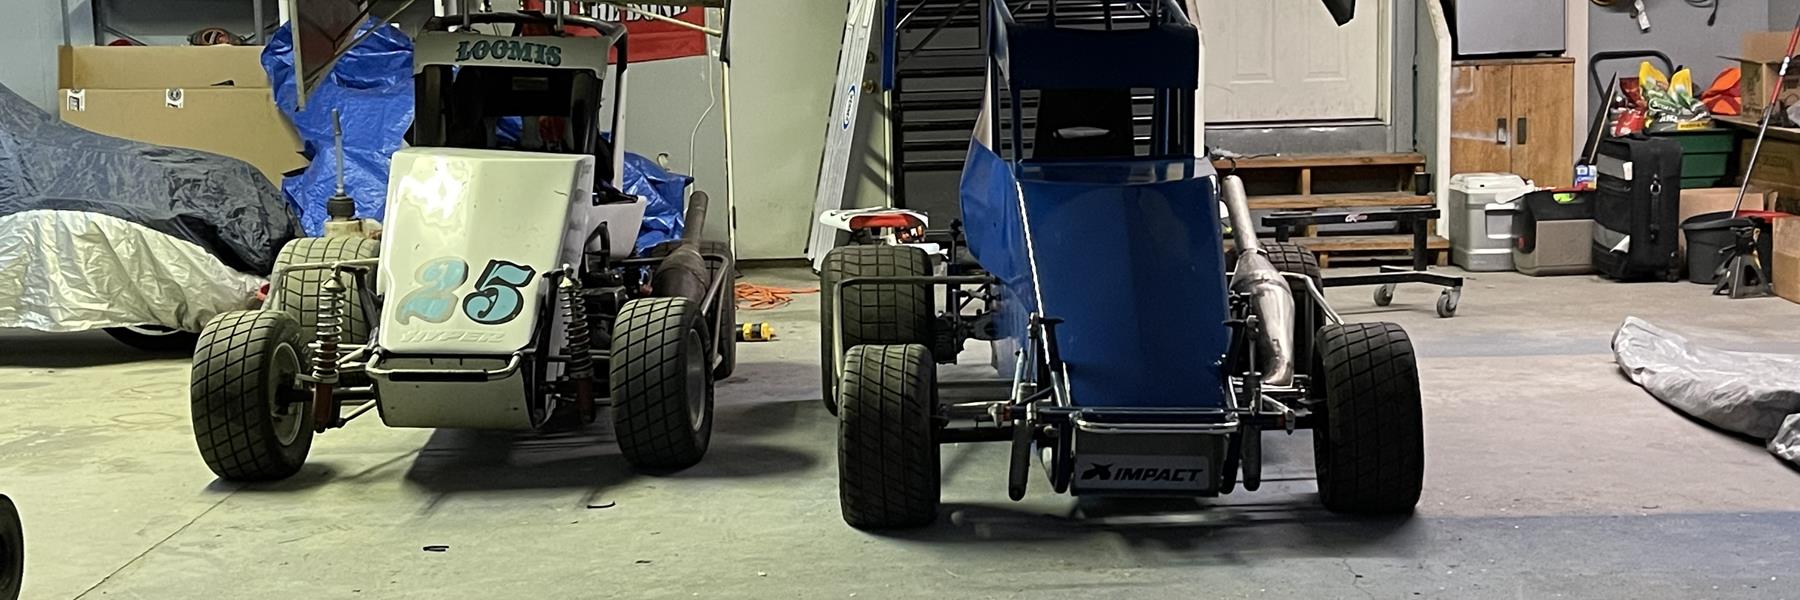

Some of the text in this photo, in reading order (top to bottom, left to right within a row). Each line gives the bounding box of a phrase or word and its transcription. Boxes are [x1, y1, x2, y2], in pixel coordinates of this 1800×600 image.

[455, 39, 562, 67] LOOMIS
[395, 256, 536, 325] 25
[1113, 467, 1204, 482] IMPACT
